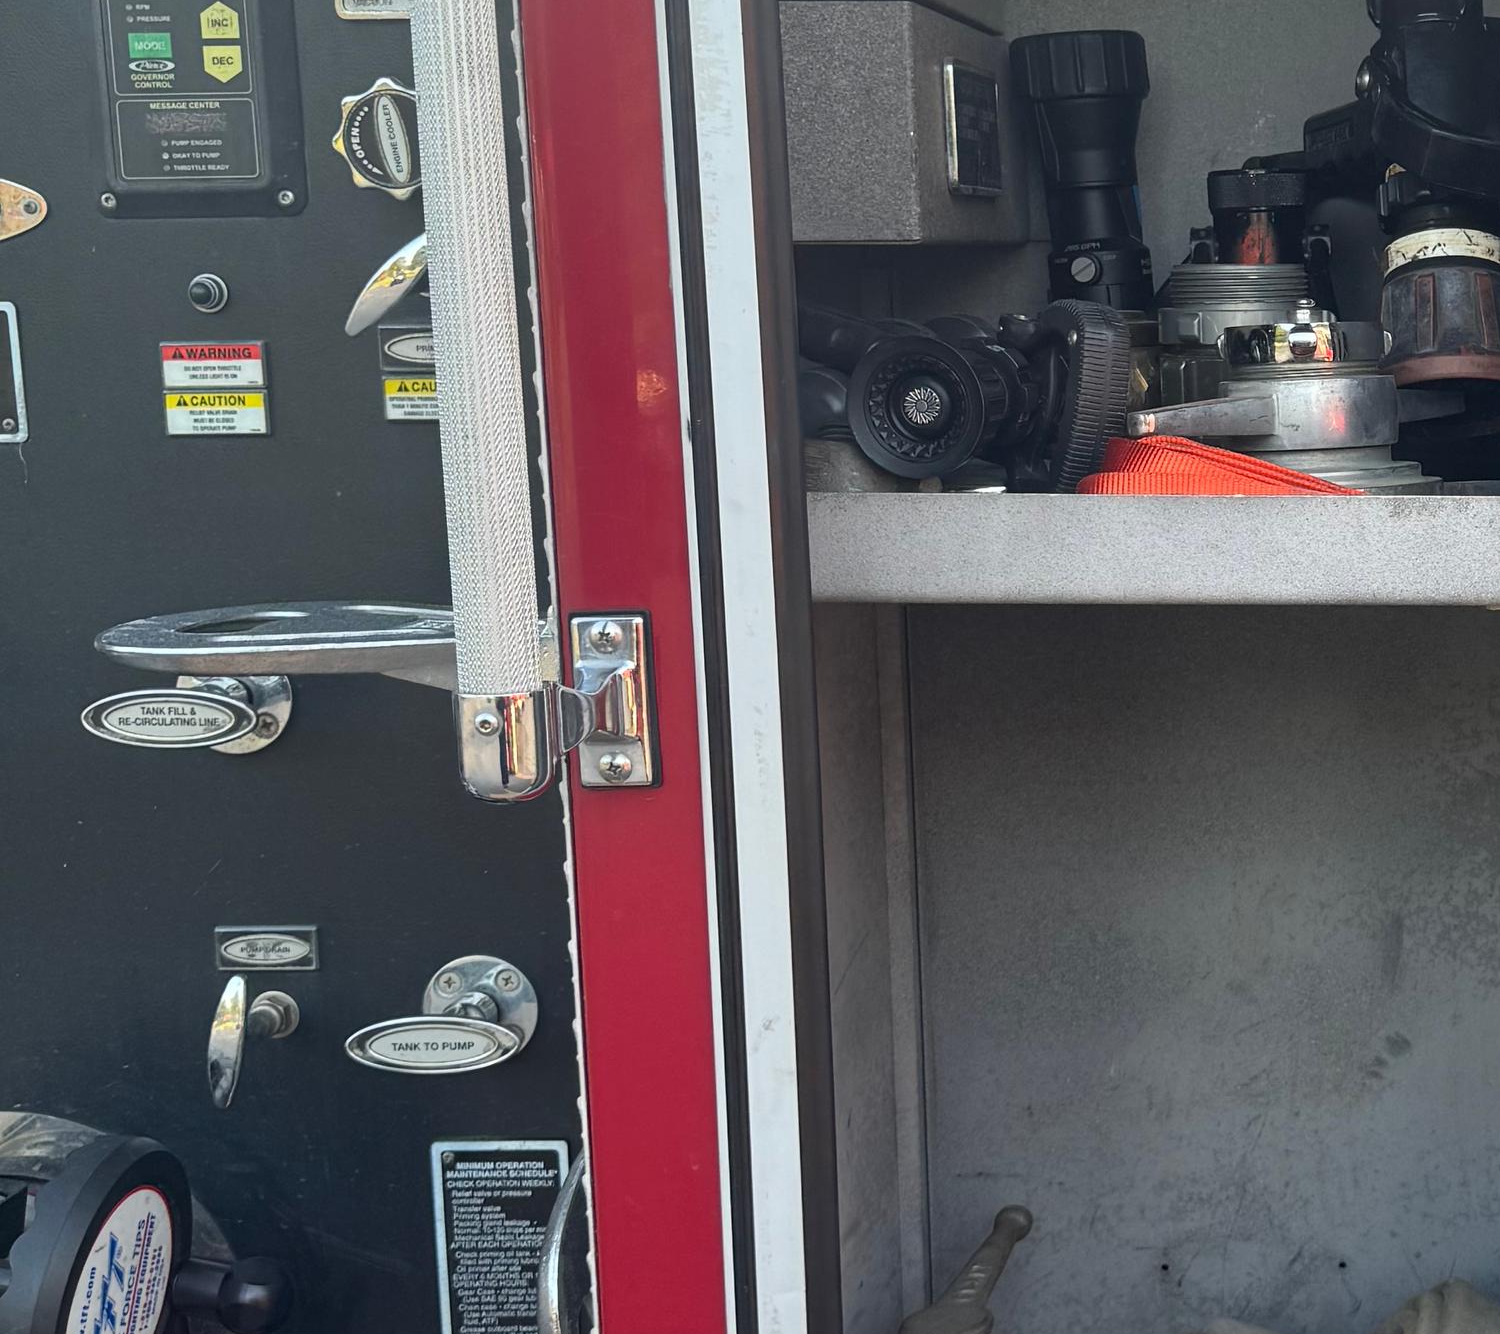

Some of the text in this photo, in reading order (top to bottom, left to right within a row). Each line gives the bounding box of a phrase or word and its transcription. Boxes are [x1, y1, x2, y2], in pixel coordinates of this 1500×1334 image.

[210, 19, 229, 28] INC
[135, 41, 166, 50] MODE
[212, 57, 234, 65] DEC
[189, 101, 220, 109] CENTER
[351, 128, 365, 158] OPEN
[382, 104, 404, 173] ENGINE COOLER
[185, 347, 252, 359] WARNING
[411, 381, 437, 392] CAU
[190, 395, 246, 406] CAUTION
[140, 707, 196, 716] TANK FILL &
[119, 717, 221, 727] RE-CIRCULATING LINE
[392, 1041, 475, 1051] TANK TO PUMP
[456, 1161, 544, 1170] MINIMUM OPERATION
[446, 1170, 508, 1178] MAINTENANCE
[475, 1179, 521, 1187] OPERATION
[139, 1214, 156, 1286] EQUIPMENT
[120, 1264, 137, 1327] FORCE
[132, 1218, 146, 1259] TIPS
